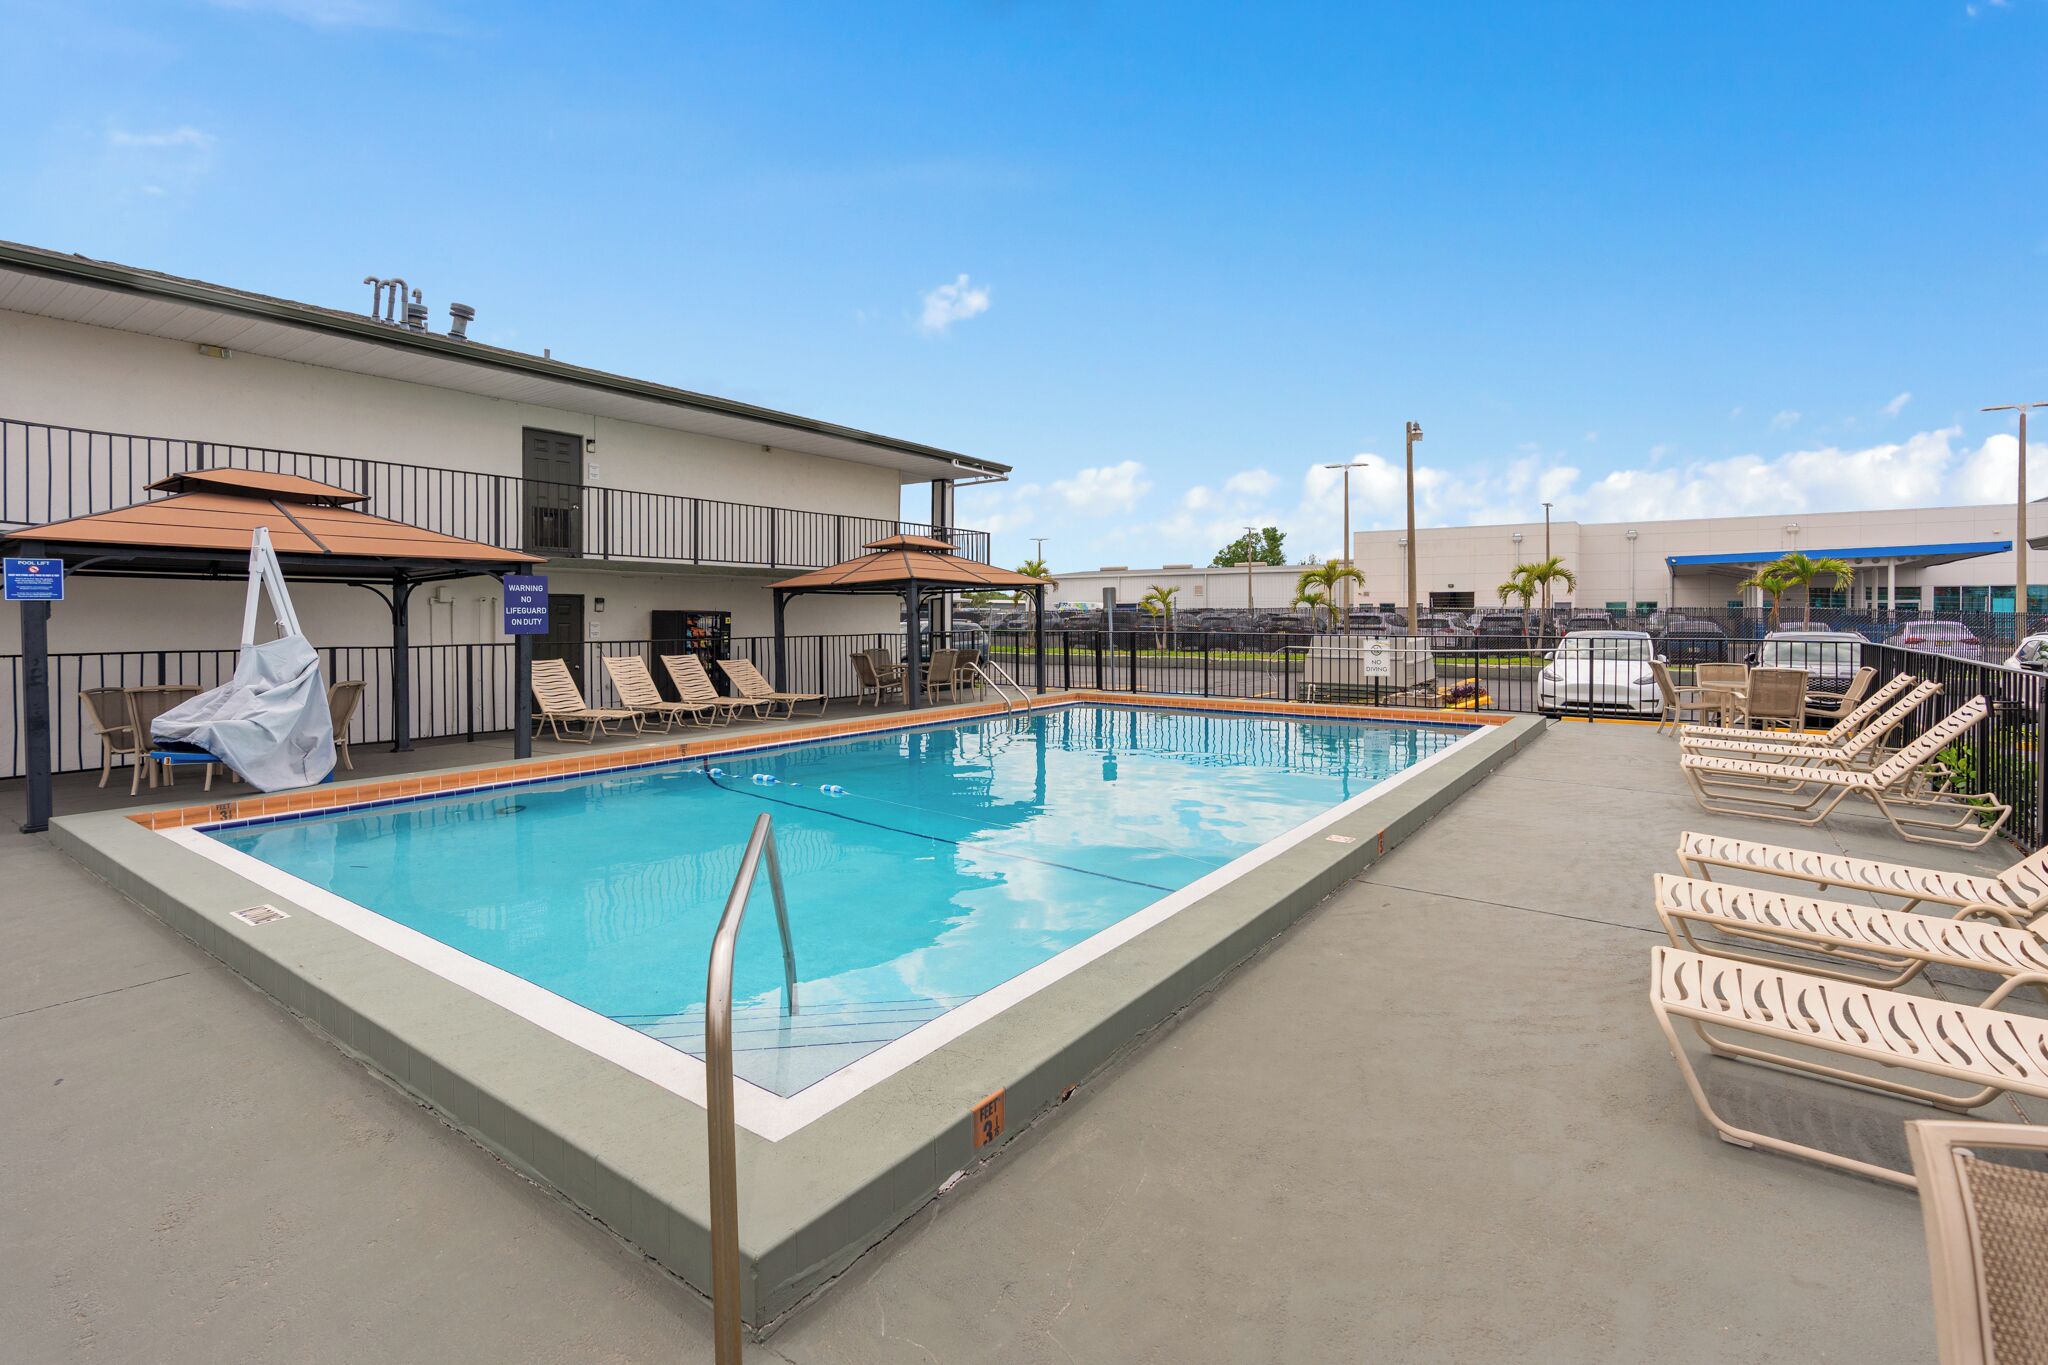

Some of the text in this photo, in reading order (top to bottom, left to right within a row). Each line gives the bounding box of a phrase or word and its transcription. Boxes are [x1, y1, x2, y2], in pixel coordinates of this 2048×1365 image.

[508, 584, 544, 592] WARNING
[520, 595, 532, 603] NO
[505, 607, 547, 615] LIFEGUARD
[511, 618, 542, 626] ON DUTY
